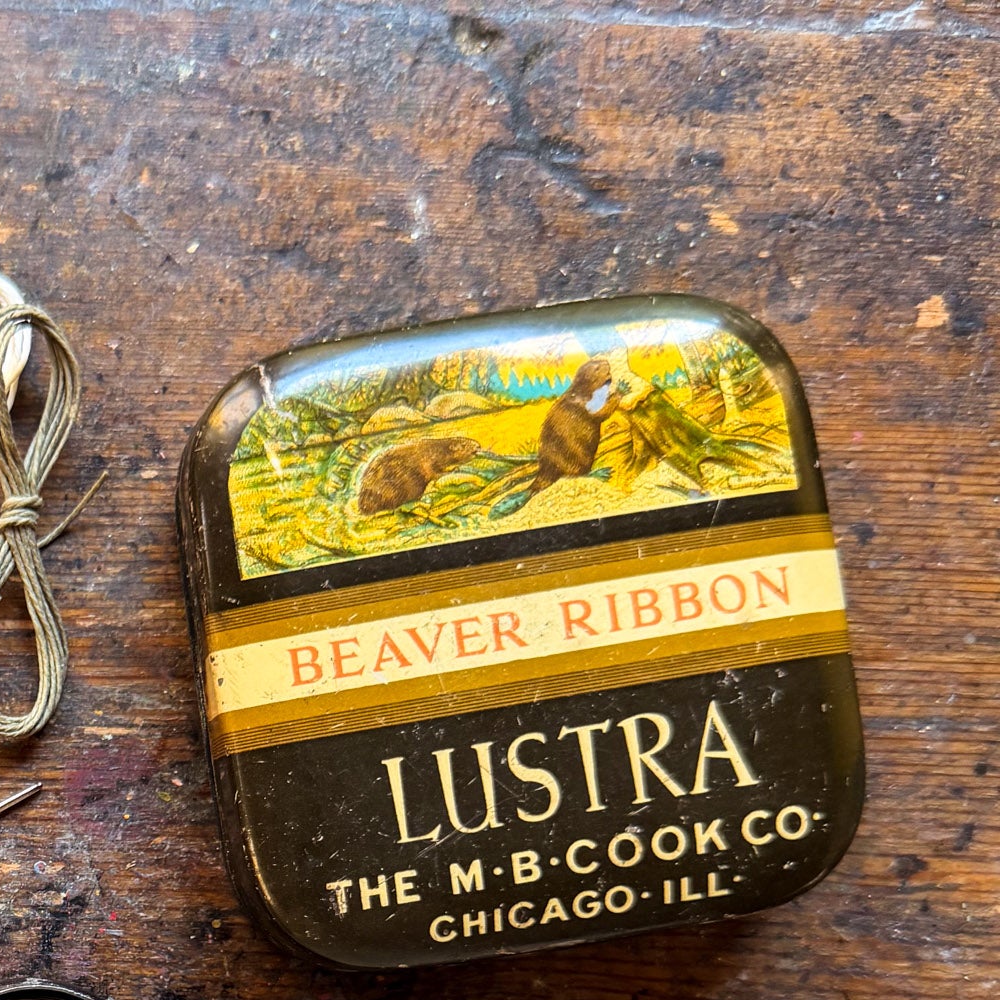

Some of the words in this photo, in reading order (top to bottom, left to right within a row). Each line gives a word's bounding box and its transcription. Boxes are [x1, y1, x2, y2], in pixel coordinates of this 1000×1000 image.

[288, 610, 527, 687] BEAVER
[558, 566, 791, 640] RIBBON
[381, 700, 760, 844] LUSTRA
[325, 870, 421, 915] THE
